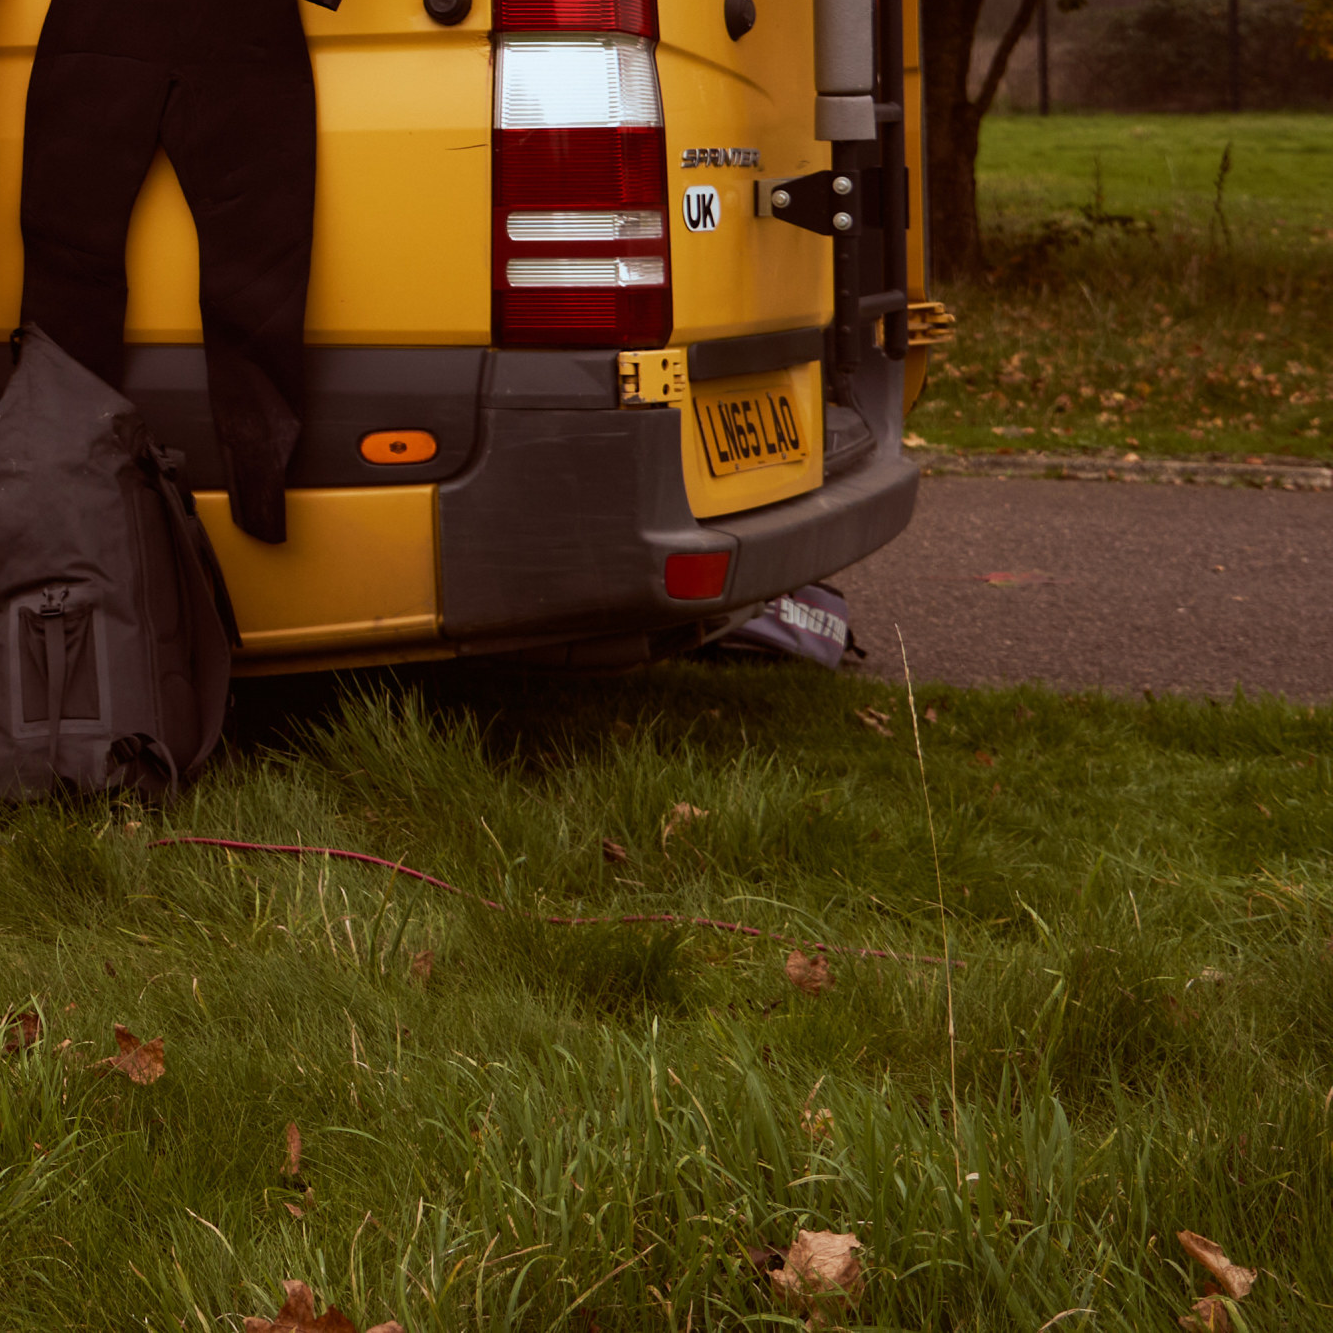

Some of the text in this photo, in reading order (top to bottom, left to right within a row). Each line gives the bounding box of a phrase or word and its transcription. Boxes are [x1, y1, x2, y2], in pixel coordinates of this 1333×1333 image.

[681, 147, 761, 168] SPRINTER
[686, 193, 716, 229] UK
[706, 401, 761, 462] LN65
